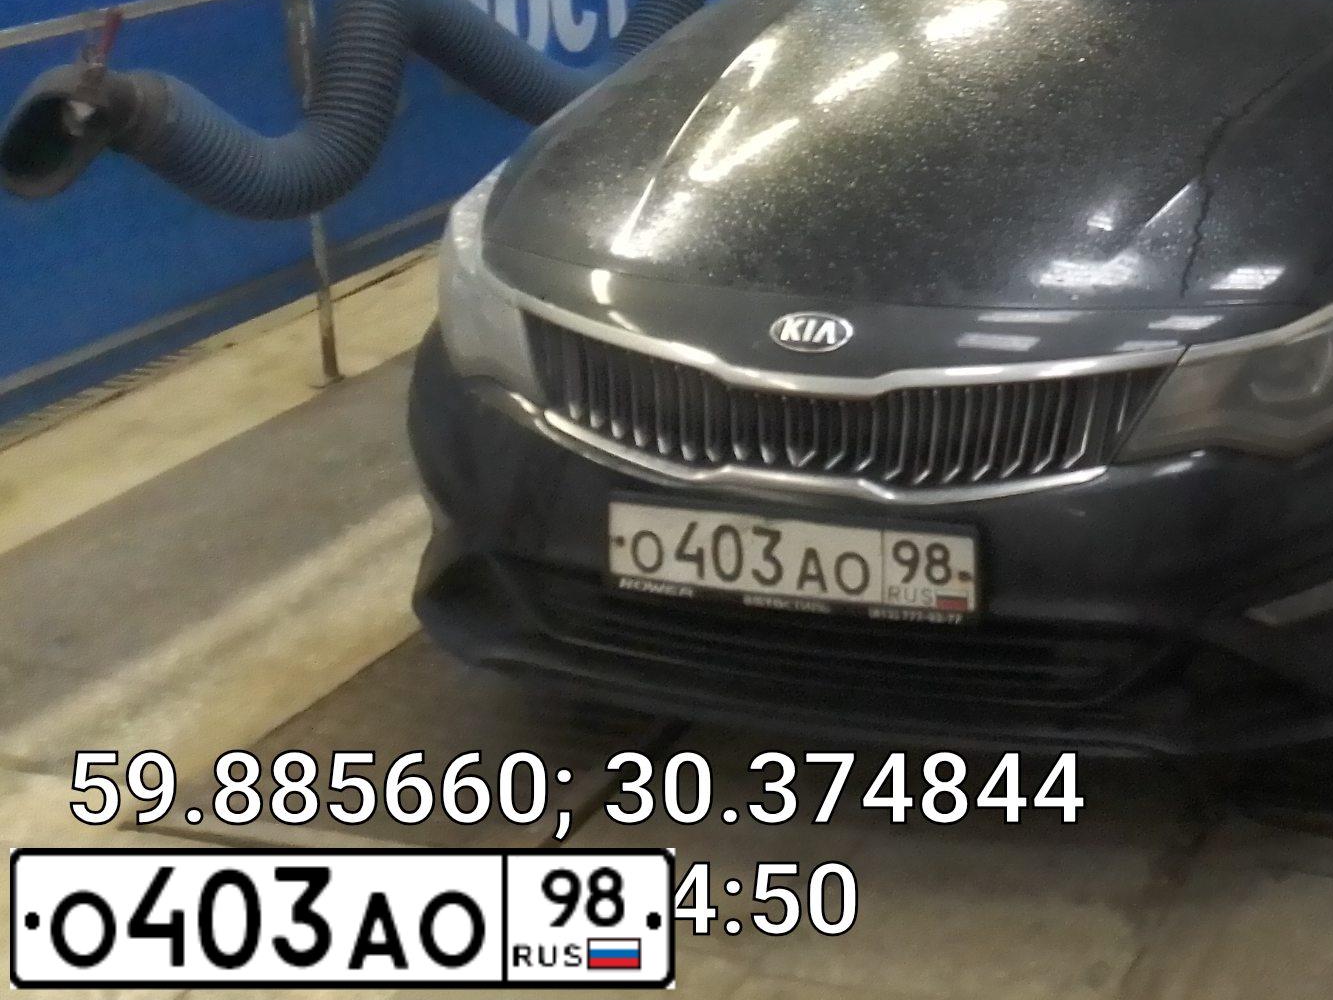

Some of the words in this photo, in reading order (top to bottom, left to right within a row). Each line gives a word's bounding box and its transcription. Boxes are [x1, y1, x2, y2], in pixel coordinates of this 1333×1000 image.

[779, 317, 838, 345] KIA
[892, 540, 951, 585] 98
[888, 585, 935, 607] RUS
